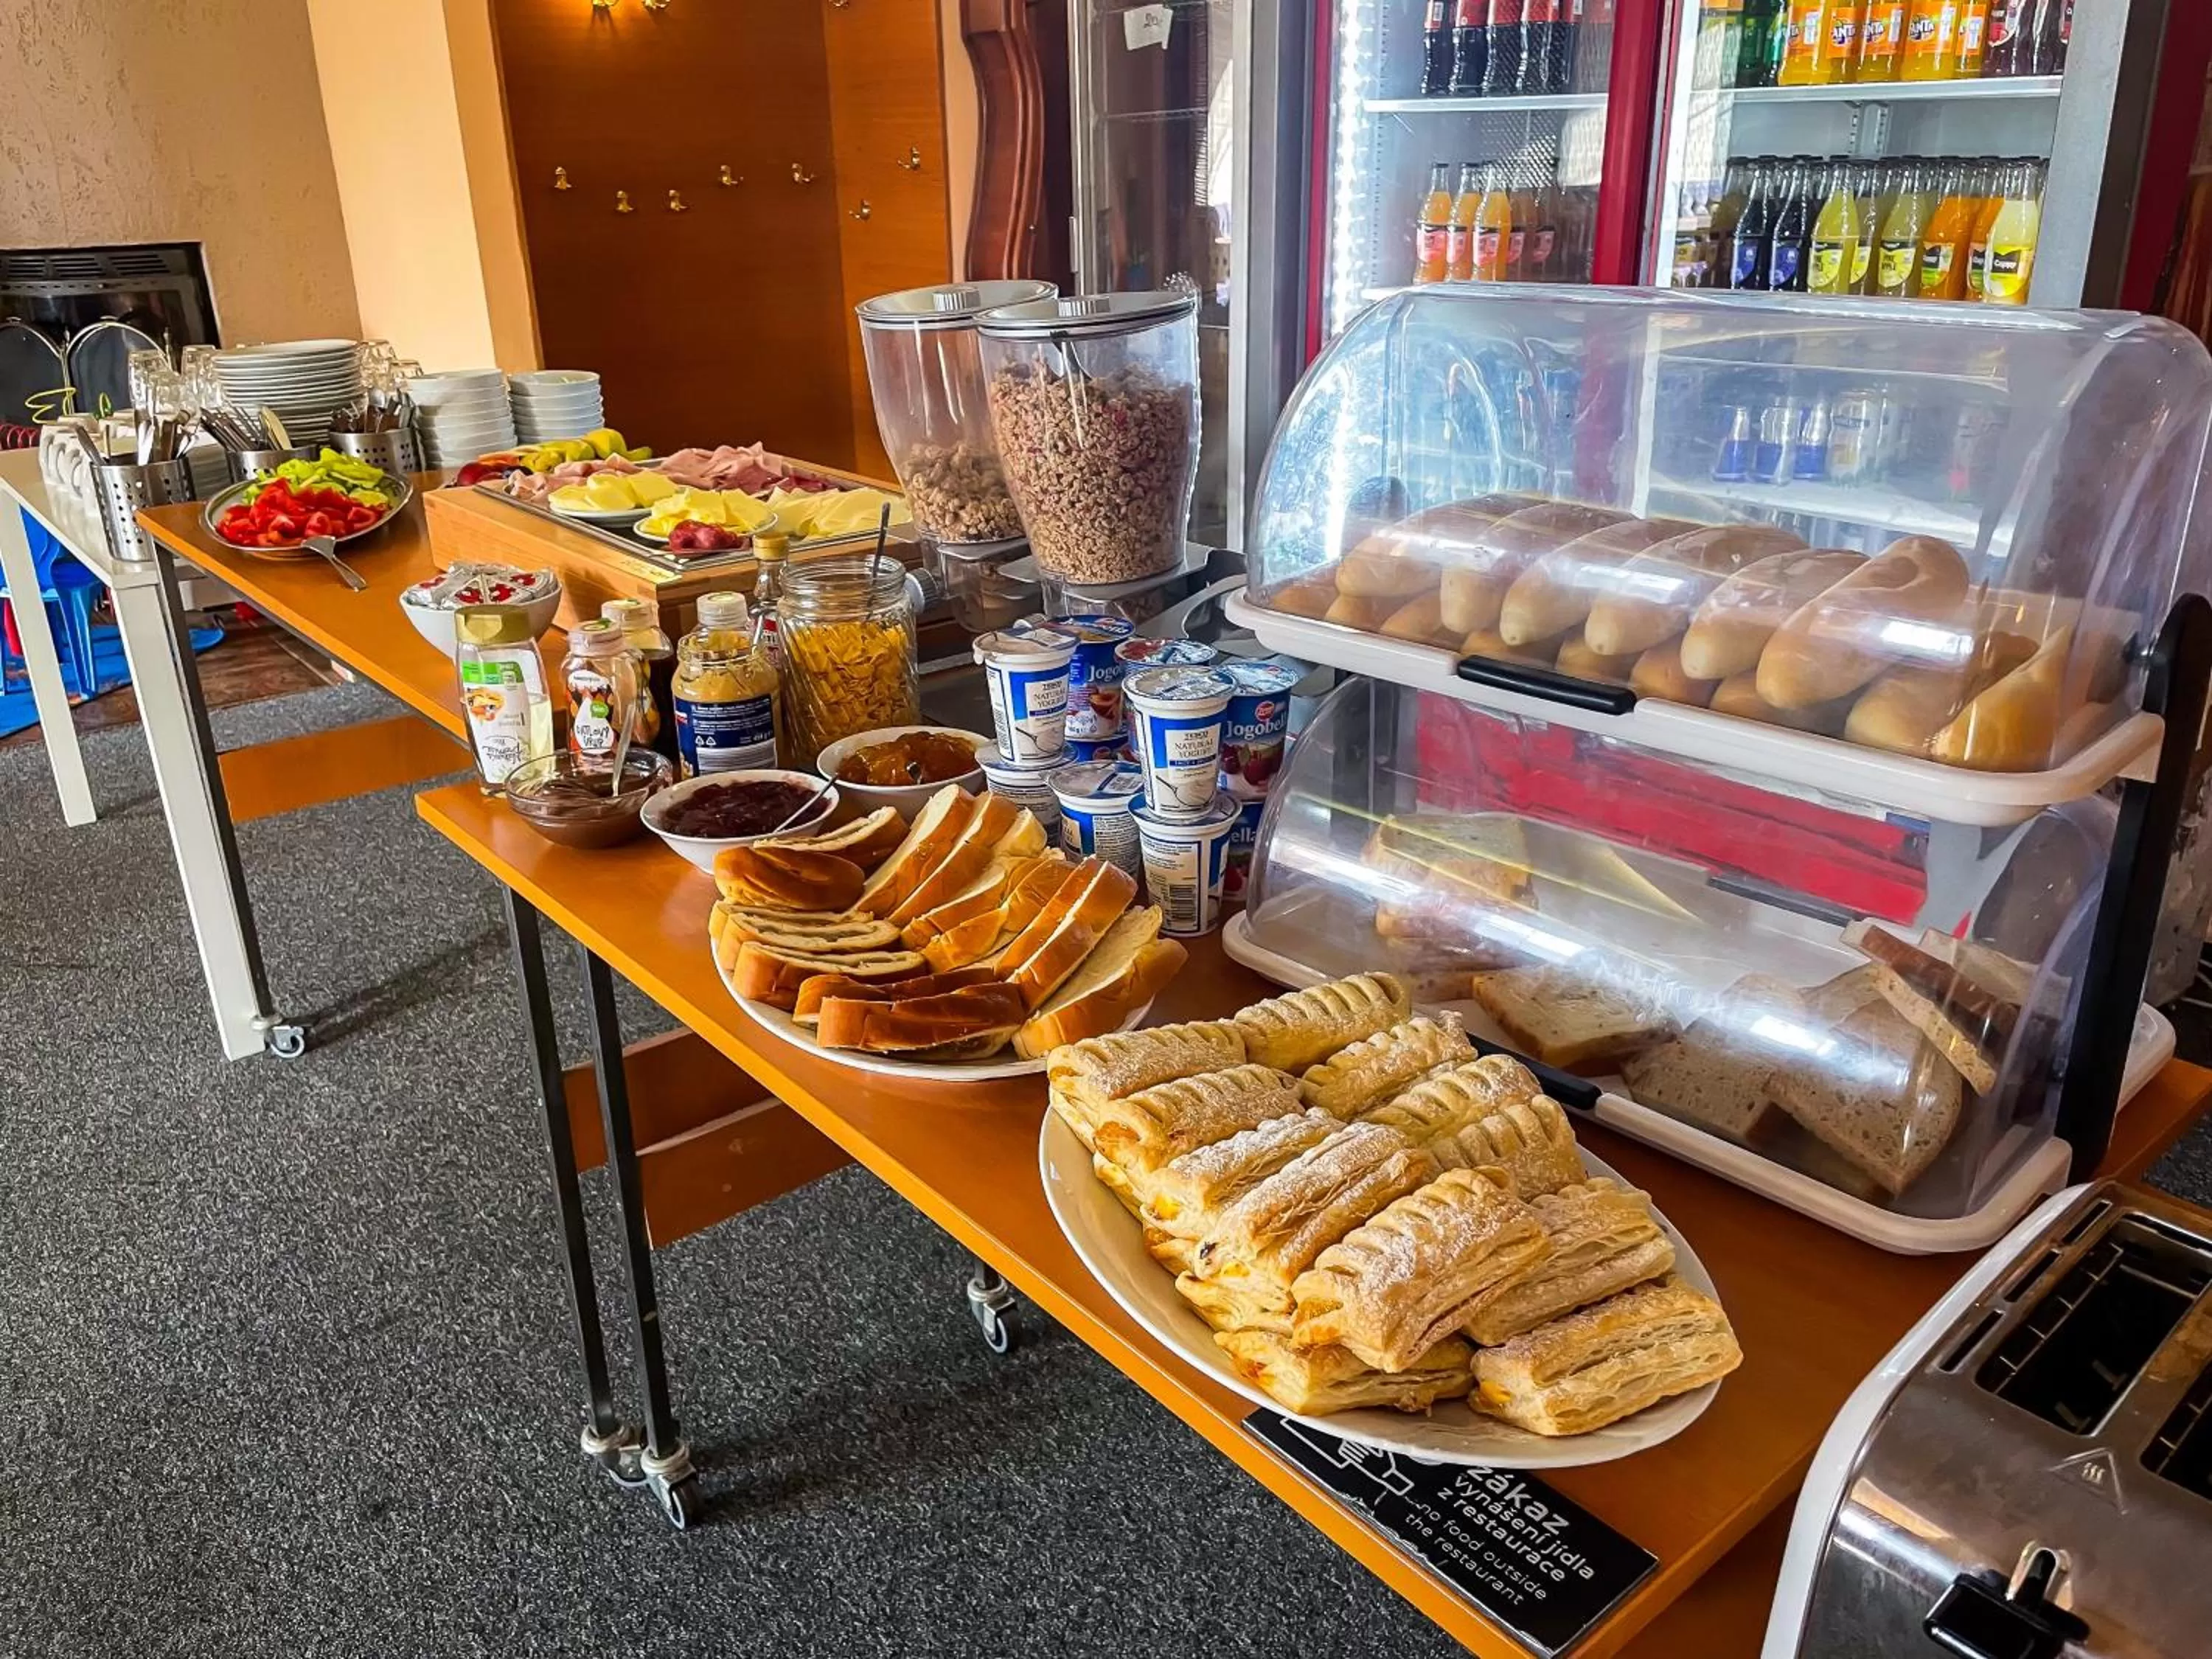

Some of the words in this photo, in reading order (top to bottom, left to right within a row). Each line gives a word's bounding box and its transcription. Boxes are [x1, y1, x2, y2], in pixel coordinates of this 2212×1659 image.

[1437, 1487, 1453, 1500] z
[1453, 1499, 1565, 1582] restaurace
[1455, 1474, 1552, 1544] vynášení
[1540, 1540, 1596, 1580] jídla
[1467, 1466, 1570, 1535] zákaz
[1405, 1513, 1433, 1537] the
[1433, 1537, 1525, 1605] restaurant
[1414, 1503, 1441, 1521] no
[1443, 1519, 1486, 1551] food
[1483, 1551, 1547, 1600] outside
